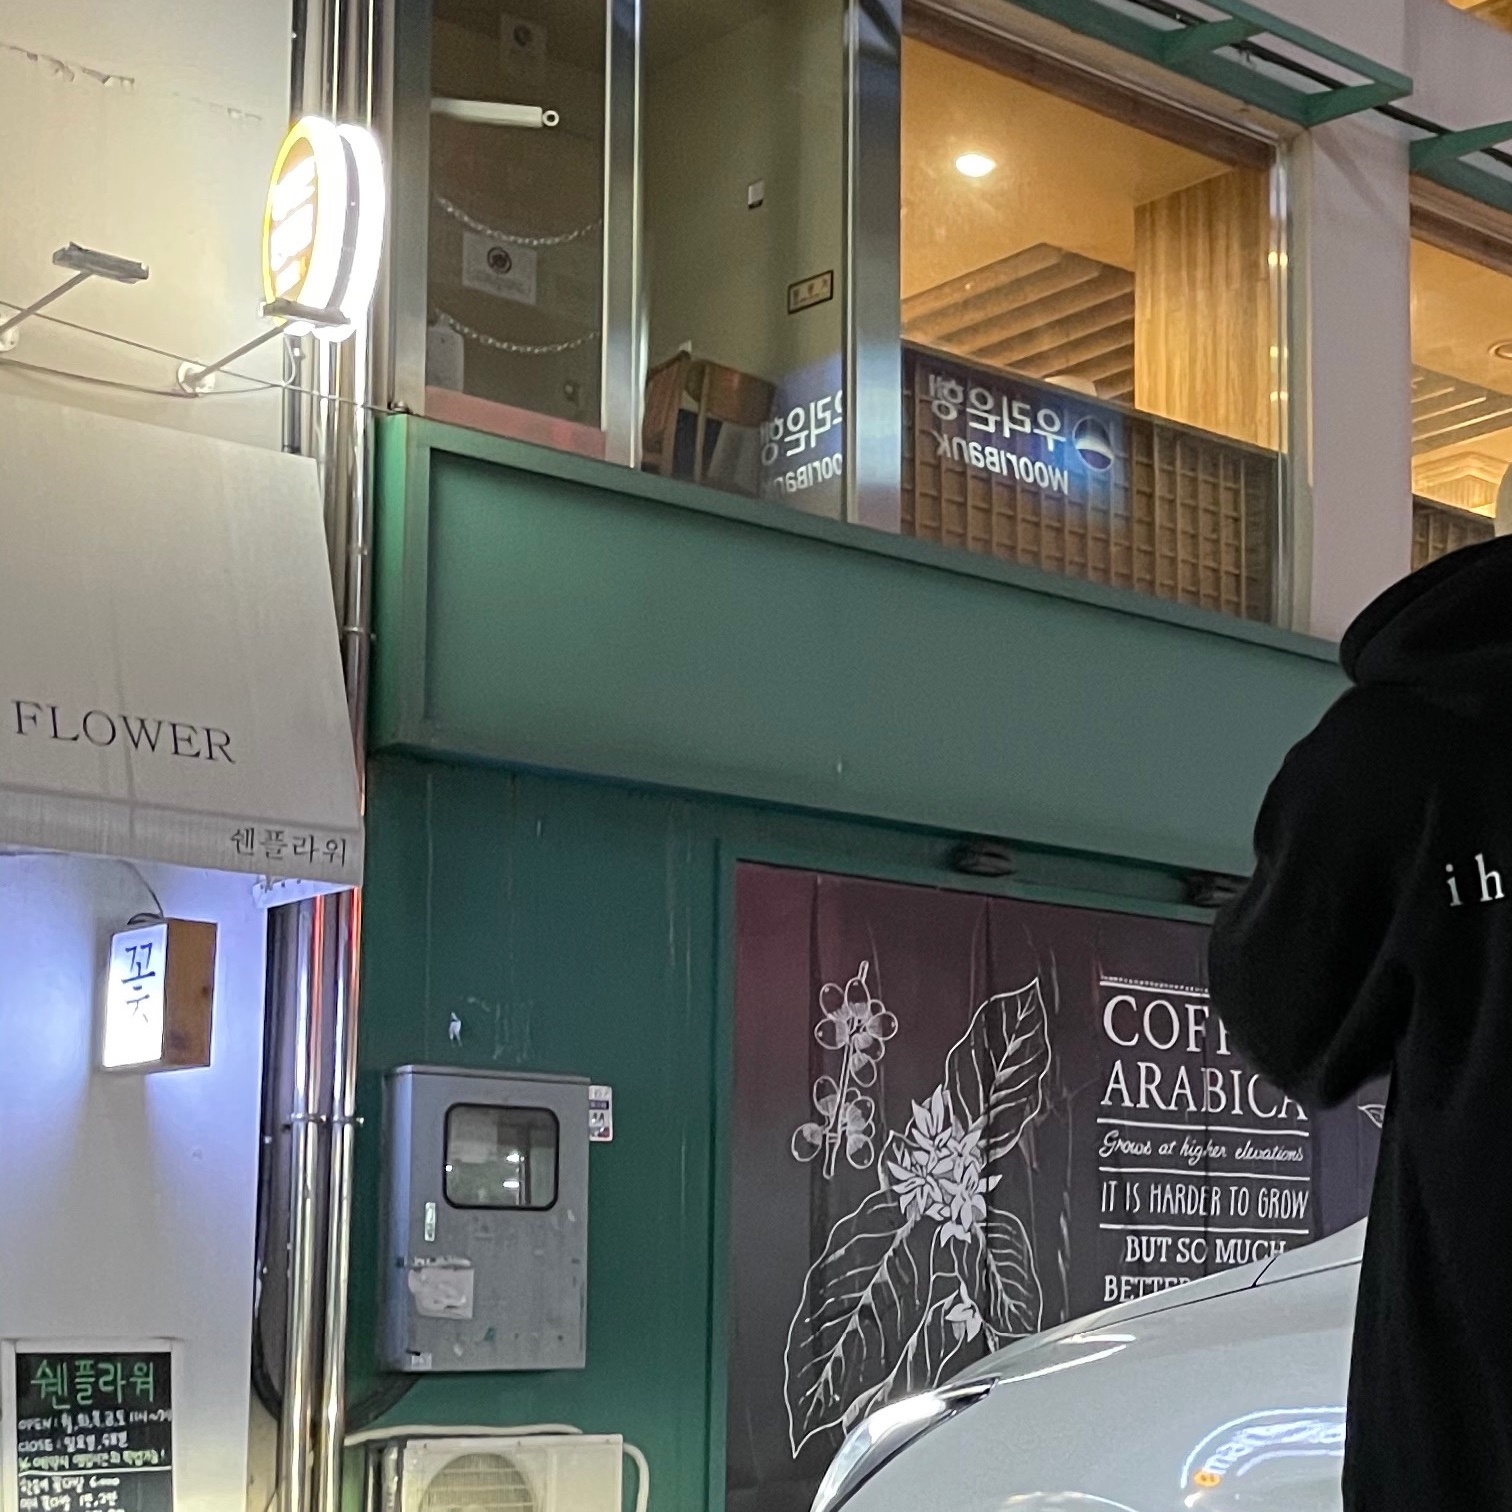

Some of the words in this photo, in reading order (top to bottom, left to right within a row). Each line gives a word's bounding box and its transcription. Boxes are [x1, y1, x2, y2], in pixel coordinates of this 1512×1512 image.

[11, 700, 236, 764] FLOWER
[1445, 853, 1504, 906] ih
[1099, 1130, 1152, 1158] Grows
[1158, 1140, 1177, 1156] at
[1179, 1136, 1227, 1166] higher
[1235, 1139, 1304, 1162] elevations
[1101, 1181, 1118, 1213] IT
[1125, 1182, 1140, 1213] IS
[1149, 1183, 1221, 1217] HARDER
[1229, 1186, 1250, 1216] TO
[1257, 1188, 1309, 1220] GROW
[1125, 1235, 1172, 1263] BUT
[1176, 1238, 1209, 1264] SO
[1104, 1274, 1190, 1303] BETT
